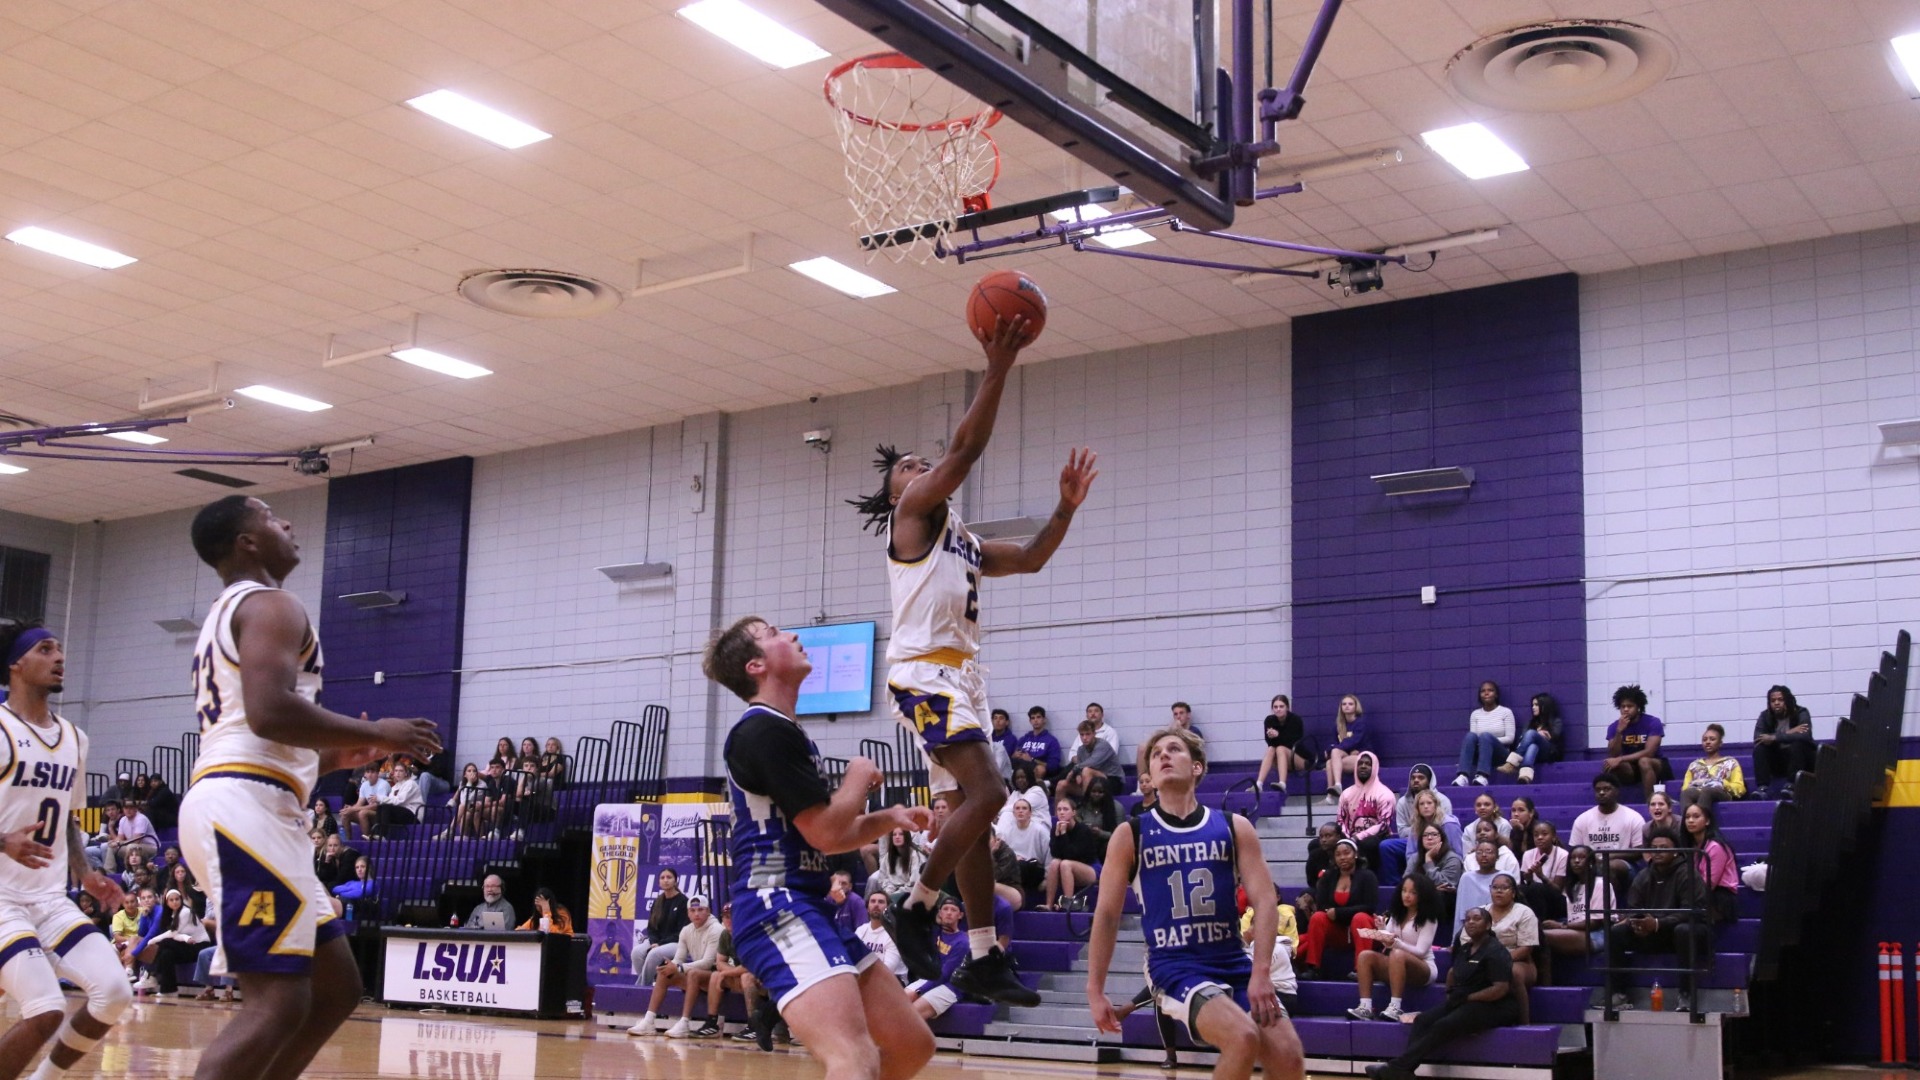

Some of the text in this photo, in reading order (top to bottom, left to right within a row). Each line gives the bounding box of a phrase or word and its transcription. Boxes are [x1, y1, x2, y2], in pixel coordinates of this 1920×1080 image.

[34, 797, 60, 846] 0
[1143, 840, 1229, 869] CENTRAL
[1167, 867, 1216, 919] 12
[413, 942, 506, 984] LSUA
[420, 988, 498, 1004] BASKETBALL
